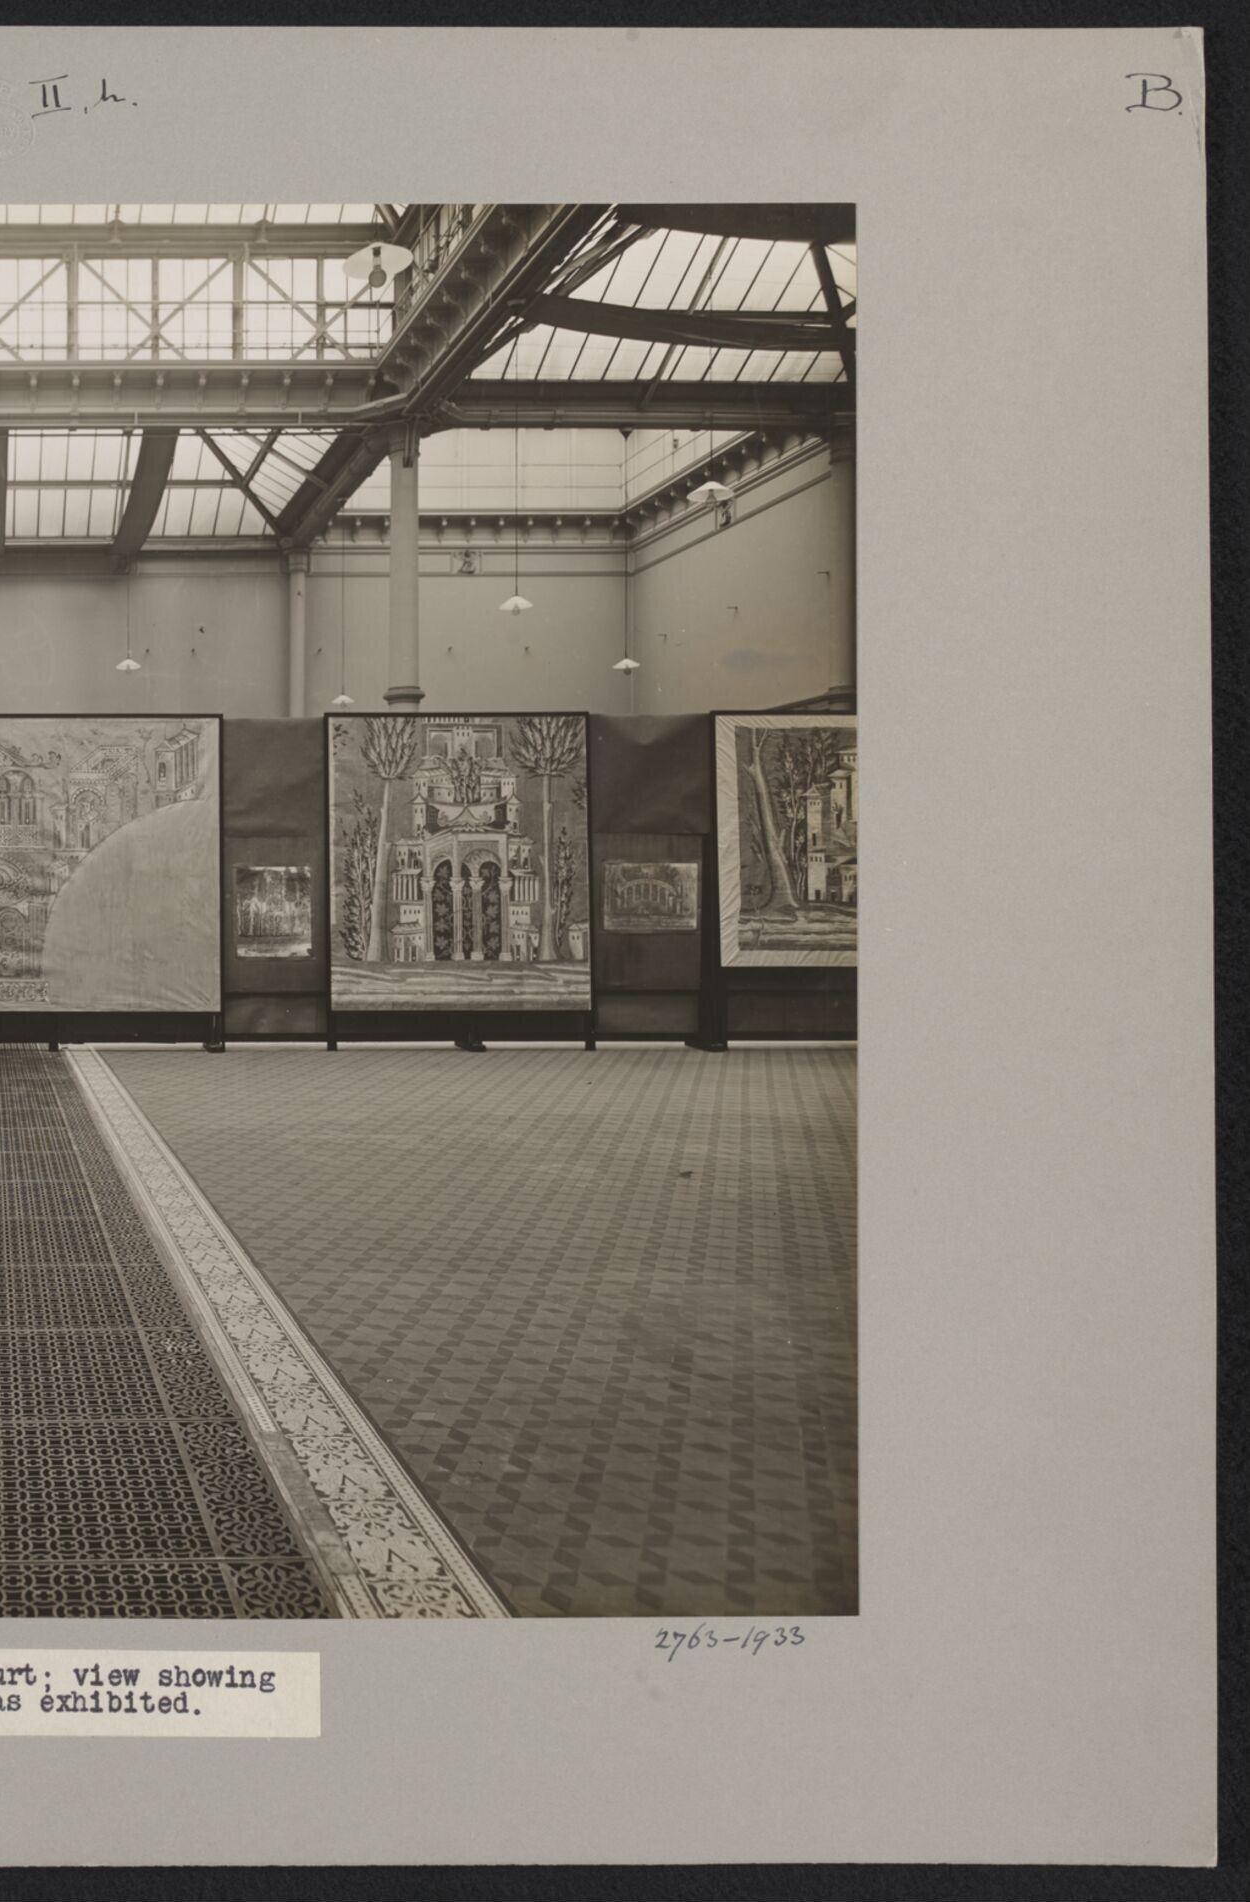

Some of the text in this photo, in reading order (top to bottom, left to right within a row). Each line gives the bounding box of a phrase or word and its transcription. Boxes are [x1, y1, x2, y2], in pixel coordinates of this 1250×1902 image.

[1125, 73, 1183, 116] B.
[654, 1623, 806, 1663] 2763-1933
[72, 1663, 141, 1687] view
[158, 1664, 276, 1694] showing
[39, 1689, 201, 1716] exhibited.
